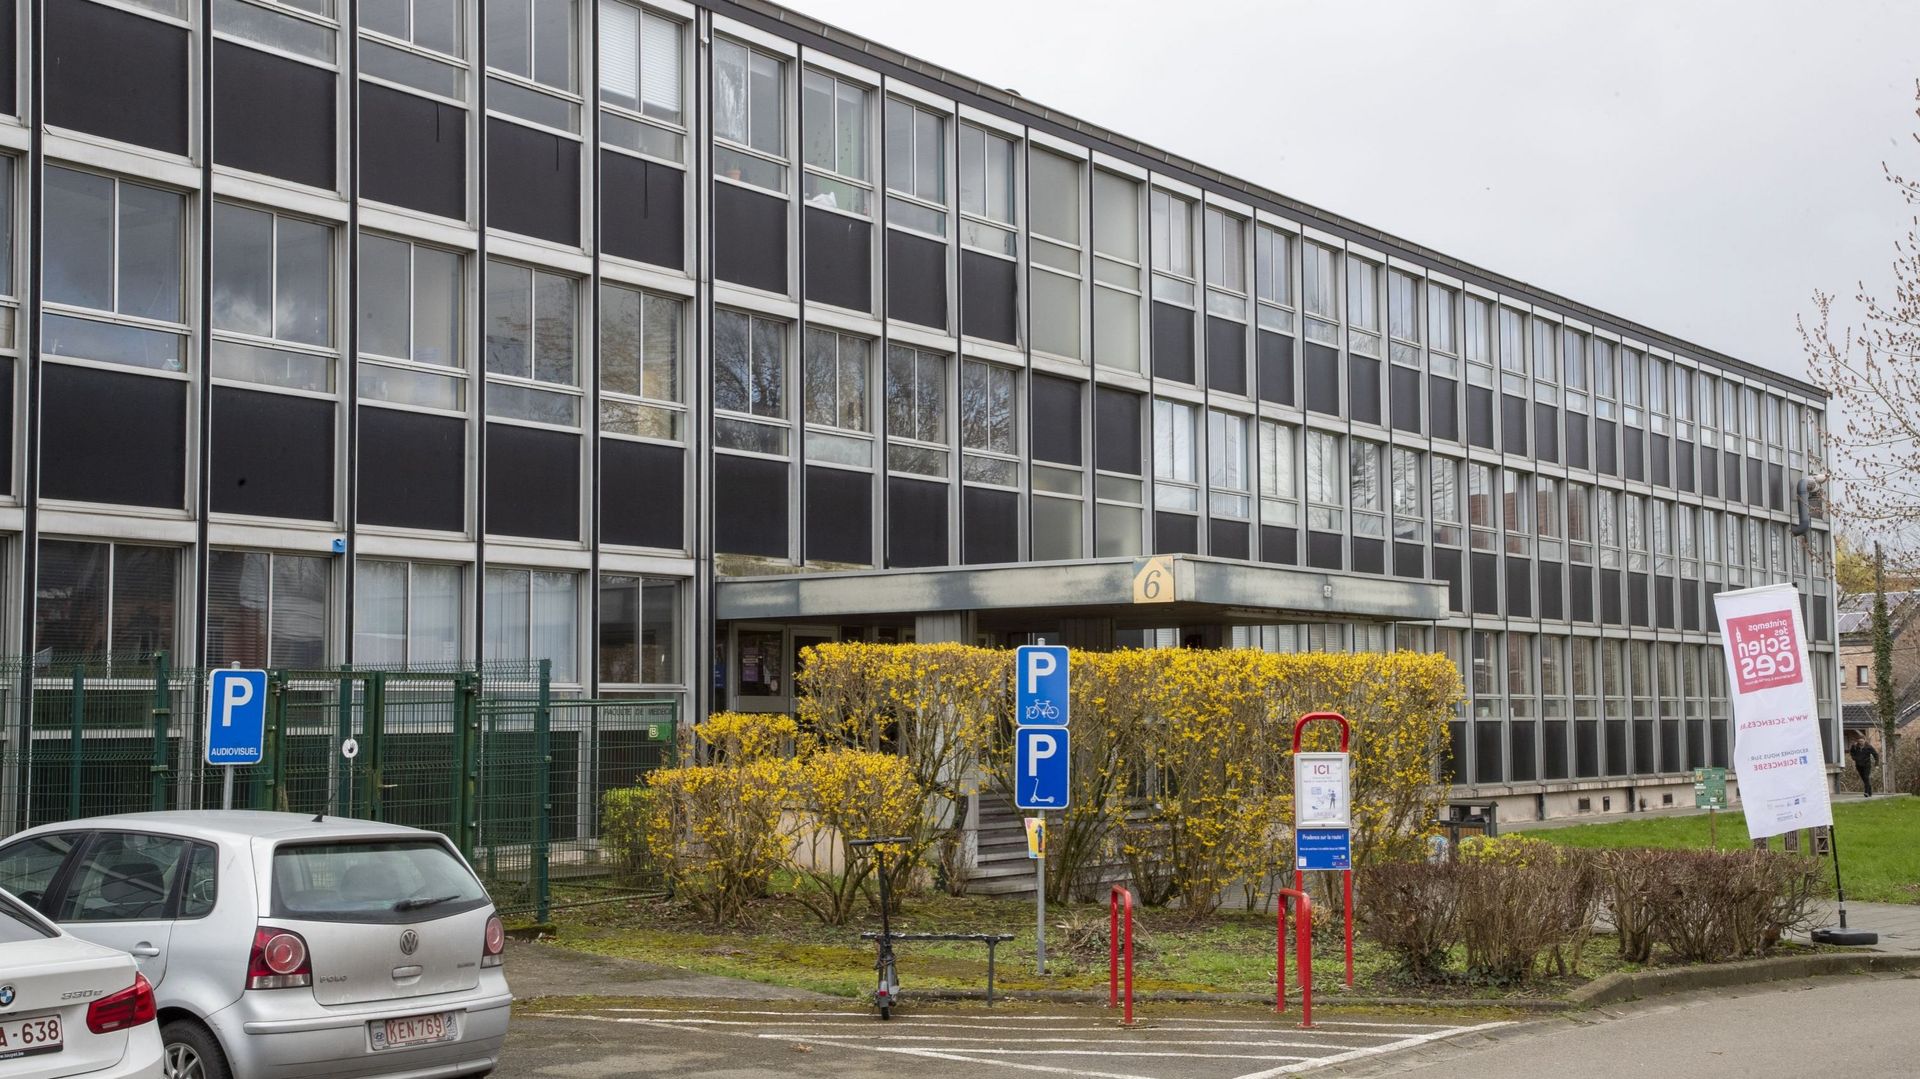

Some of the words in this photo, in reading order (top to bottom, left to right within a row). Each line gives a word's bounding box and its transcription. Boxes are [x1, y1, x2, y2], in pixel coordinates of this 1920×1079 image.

[1144, 570, 1161, 599] 6
[1028, 651, 1057, 694] P
[222, 677, 254, 727] P
[211, 747, 259, 756] AUDIOVISUEL
[1028, 734, 1057, 777] P
[1314, 765, 1330, 775] ICI
[319, 975, 348, 983] POLO
[61, 990, 103, 1000] 330e
